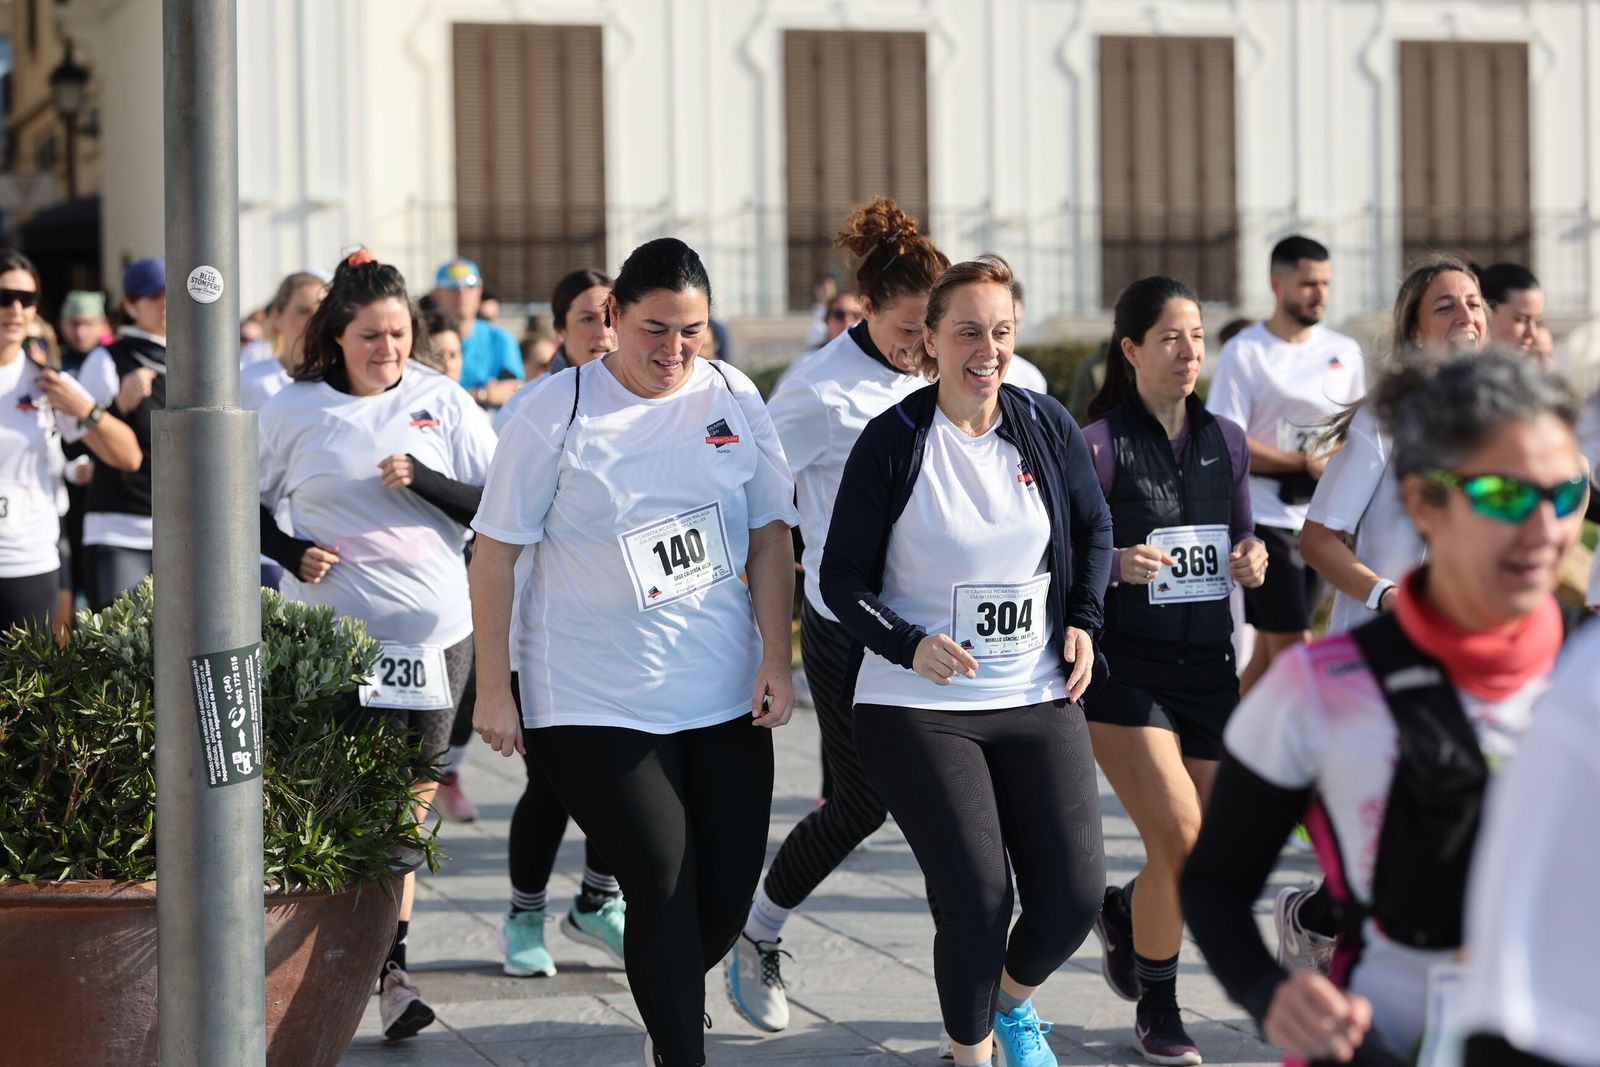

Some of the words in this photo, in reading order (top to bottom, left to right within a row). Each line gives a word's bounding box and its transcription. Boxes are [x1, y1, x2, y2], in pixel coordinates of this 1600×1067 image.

[191, 277, 220, 290] STOMPERS
[200, 272, 216, 283] BLUE
[652, 528, 706, 576] 140
[1171, 545, 1218, 578] 369
[976, 598, 1032, 636] 304
[223, 676, 233, 693] (34)
[381, 658, 426, 688] 230
[193, 669, 204, 709] estacionamiento
[202, 684, 210, 709] contacto
[208, 718, 216, 743] póngase
[211, 702, 220, 730] seguridad
[218, 740, 228, 782] Departamento
